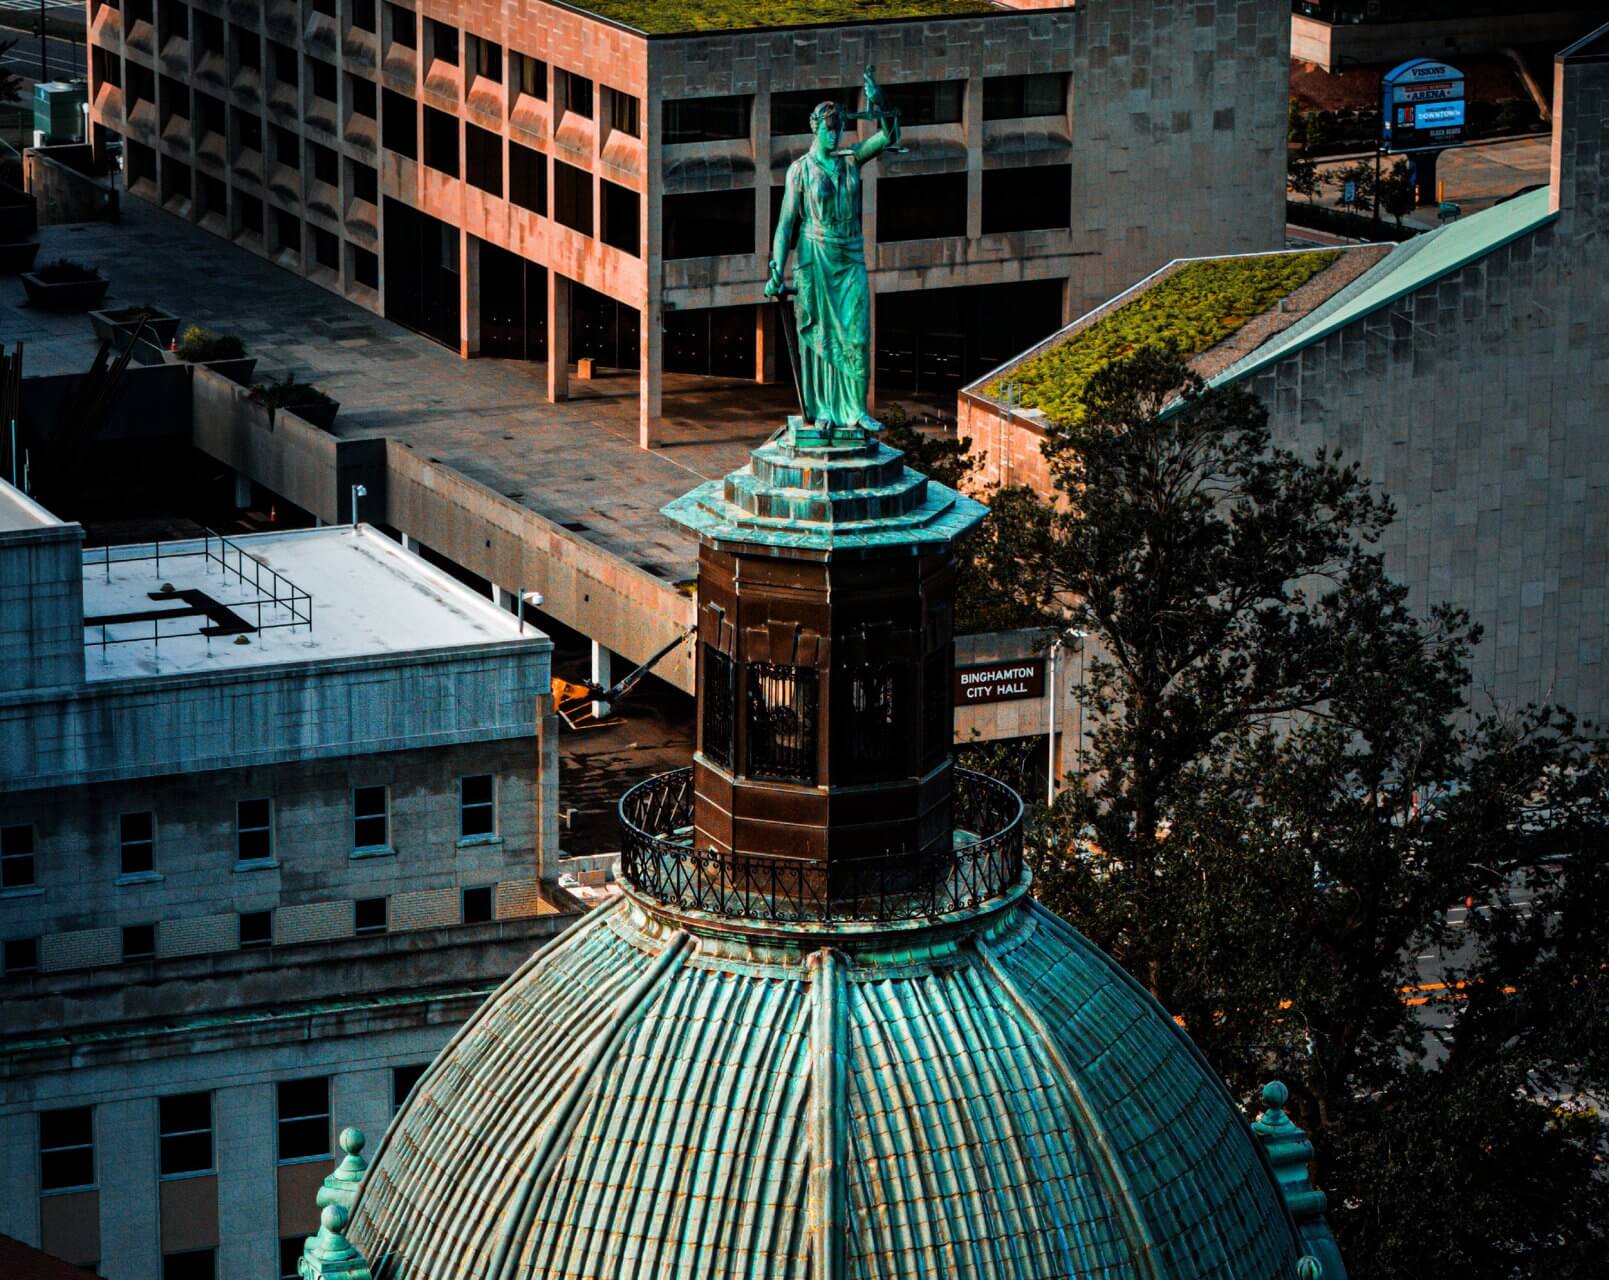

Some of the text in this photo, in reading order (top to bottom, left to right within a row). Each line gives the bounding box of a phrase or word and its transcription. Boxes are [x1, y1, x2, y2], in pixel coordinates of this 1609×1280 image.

[1412, 89, 1446, 100] ARENA
[960, 667, 1034, 685] BINGHAMTON
[966, 682, 1028, 698] CITY HALL
